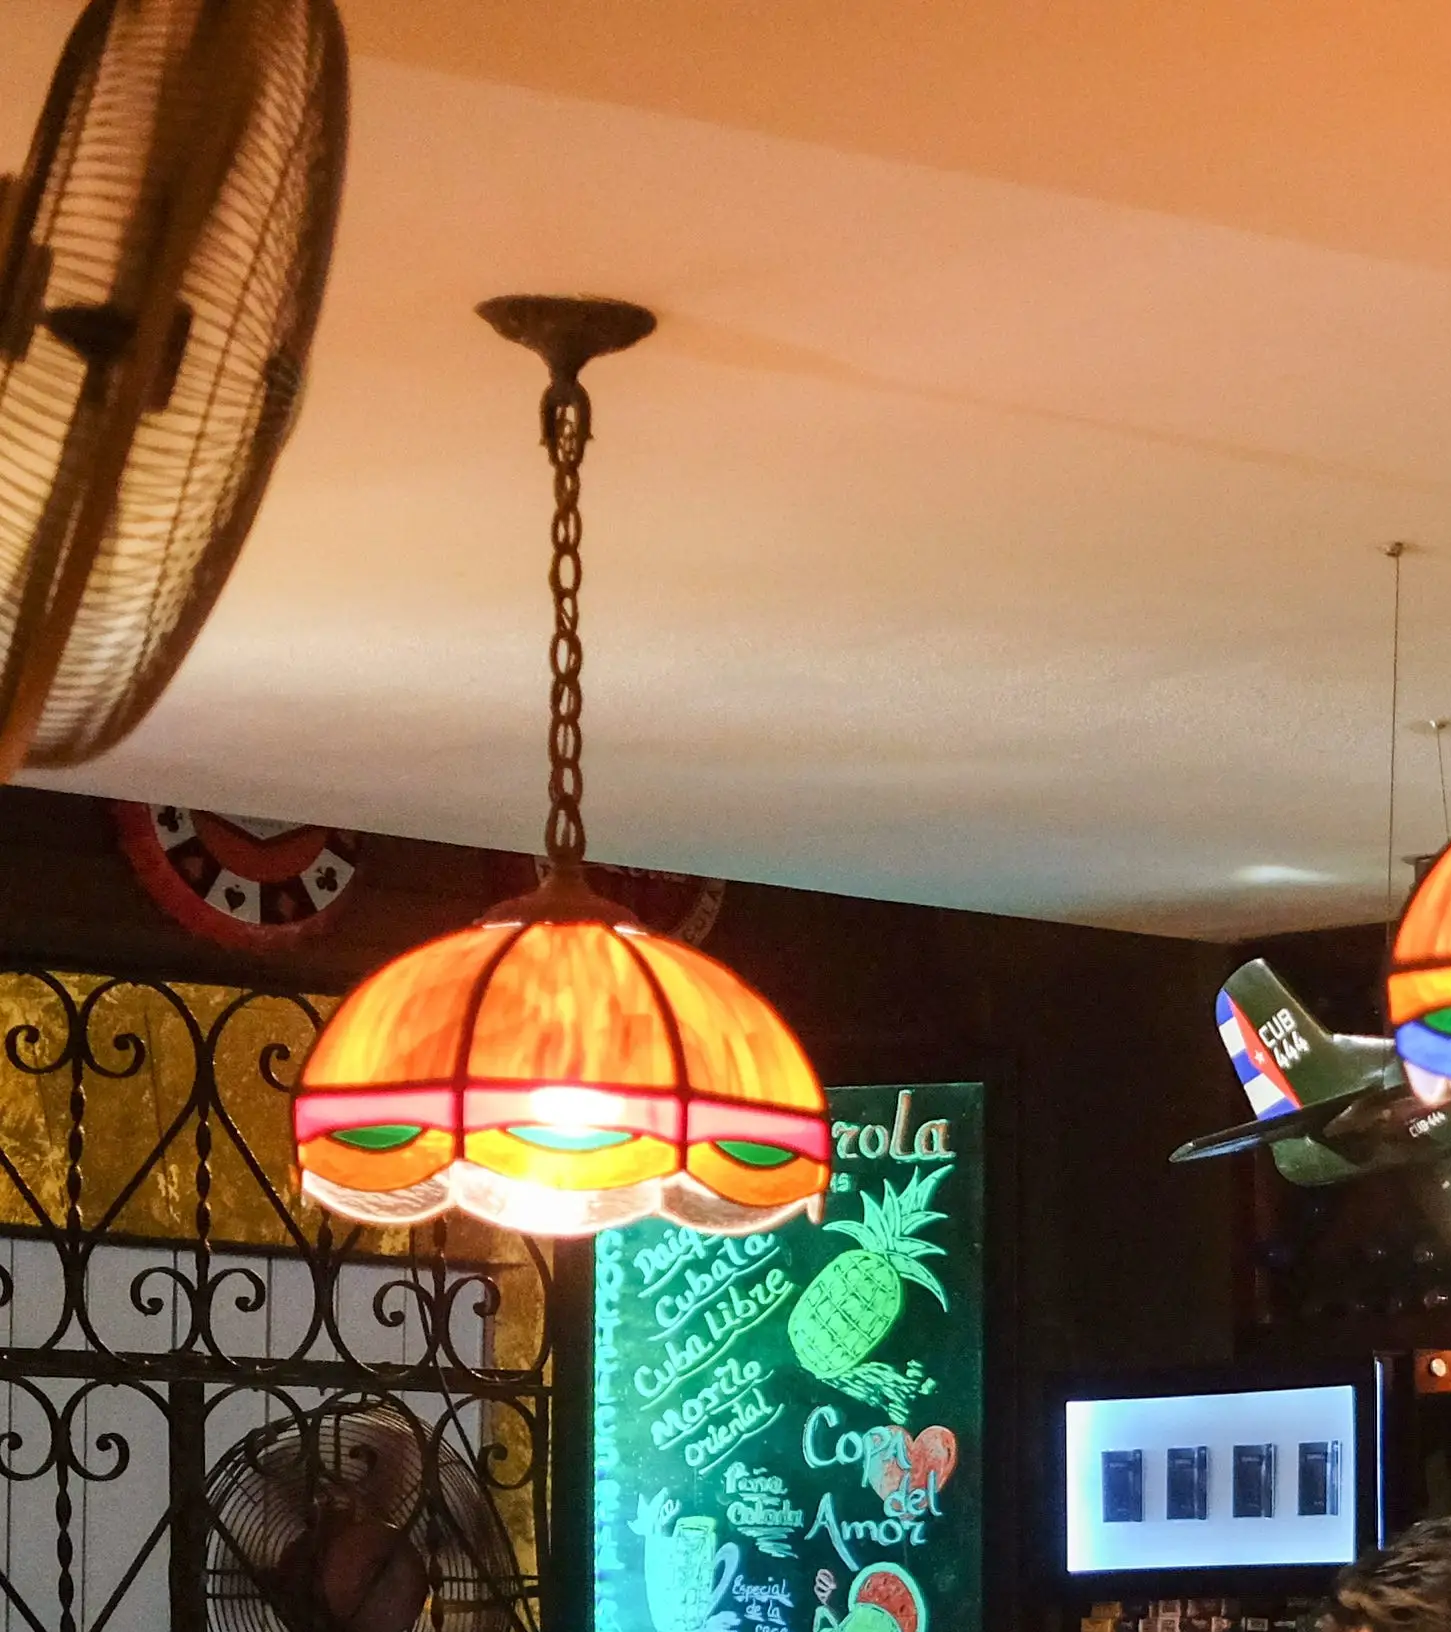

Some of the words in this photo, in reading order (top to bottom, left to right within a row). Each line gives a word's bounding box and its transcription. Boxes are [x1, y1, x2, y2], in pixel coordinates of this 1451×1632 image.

[1258, 1008, 1297, 1048] CUB
[1273, 1029, 1311, 1070] 444
[832, 1090, 957, 1162] rola
[634, 1332, 713, 1399] Cuba
[704, 1266, 792, 1347] Libre
[803, 1405, 911, 1488] Copa
[883, 1469, 943, 1518] del
[804, 1492, 928, 1572] Amor
[731, 1575, 792, 1600] Especial
